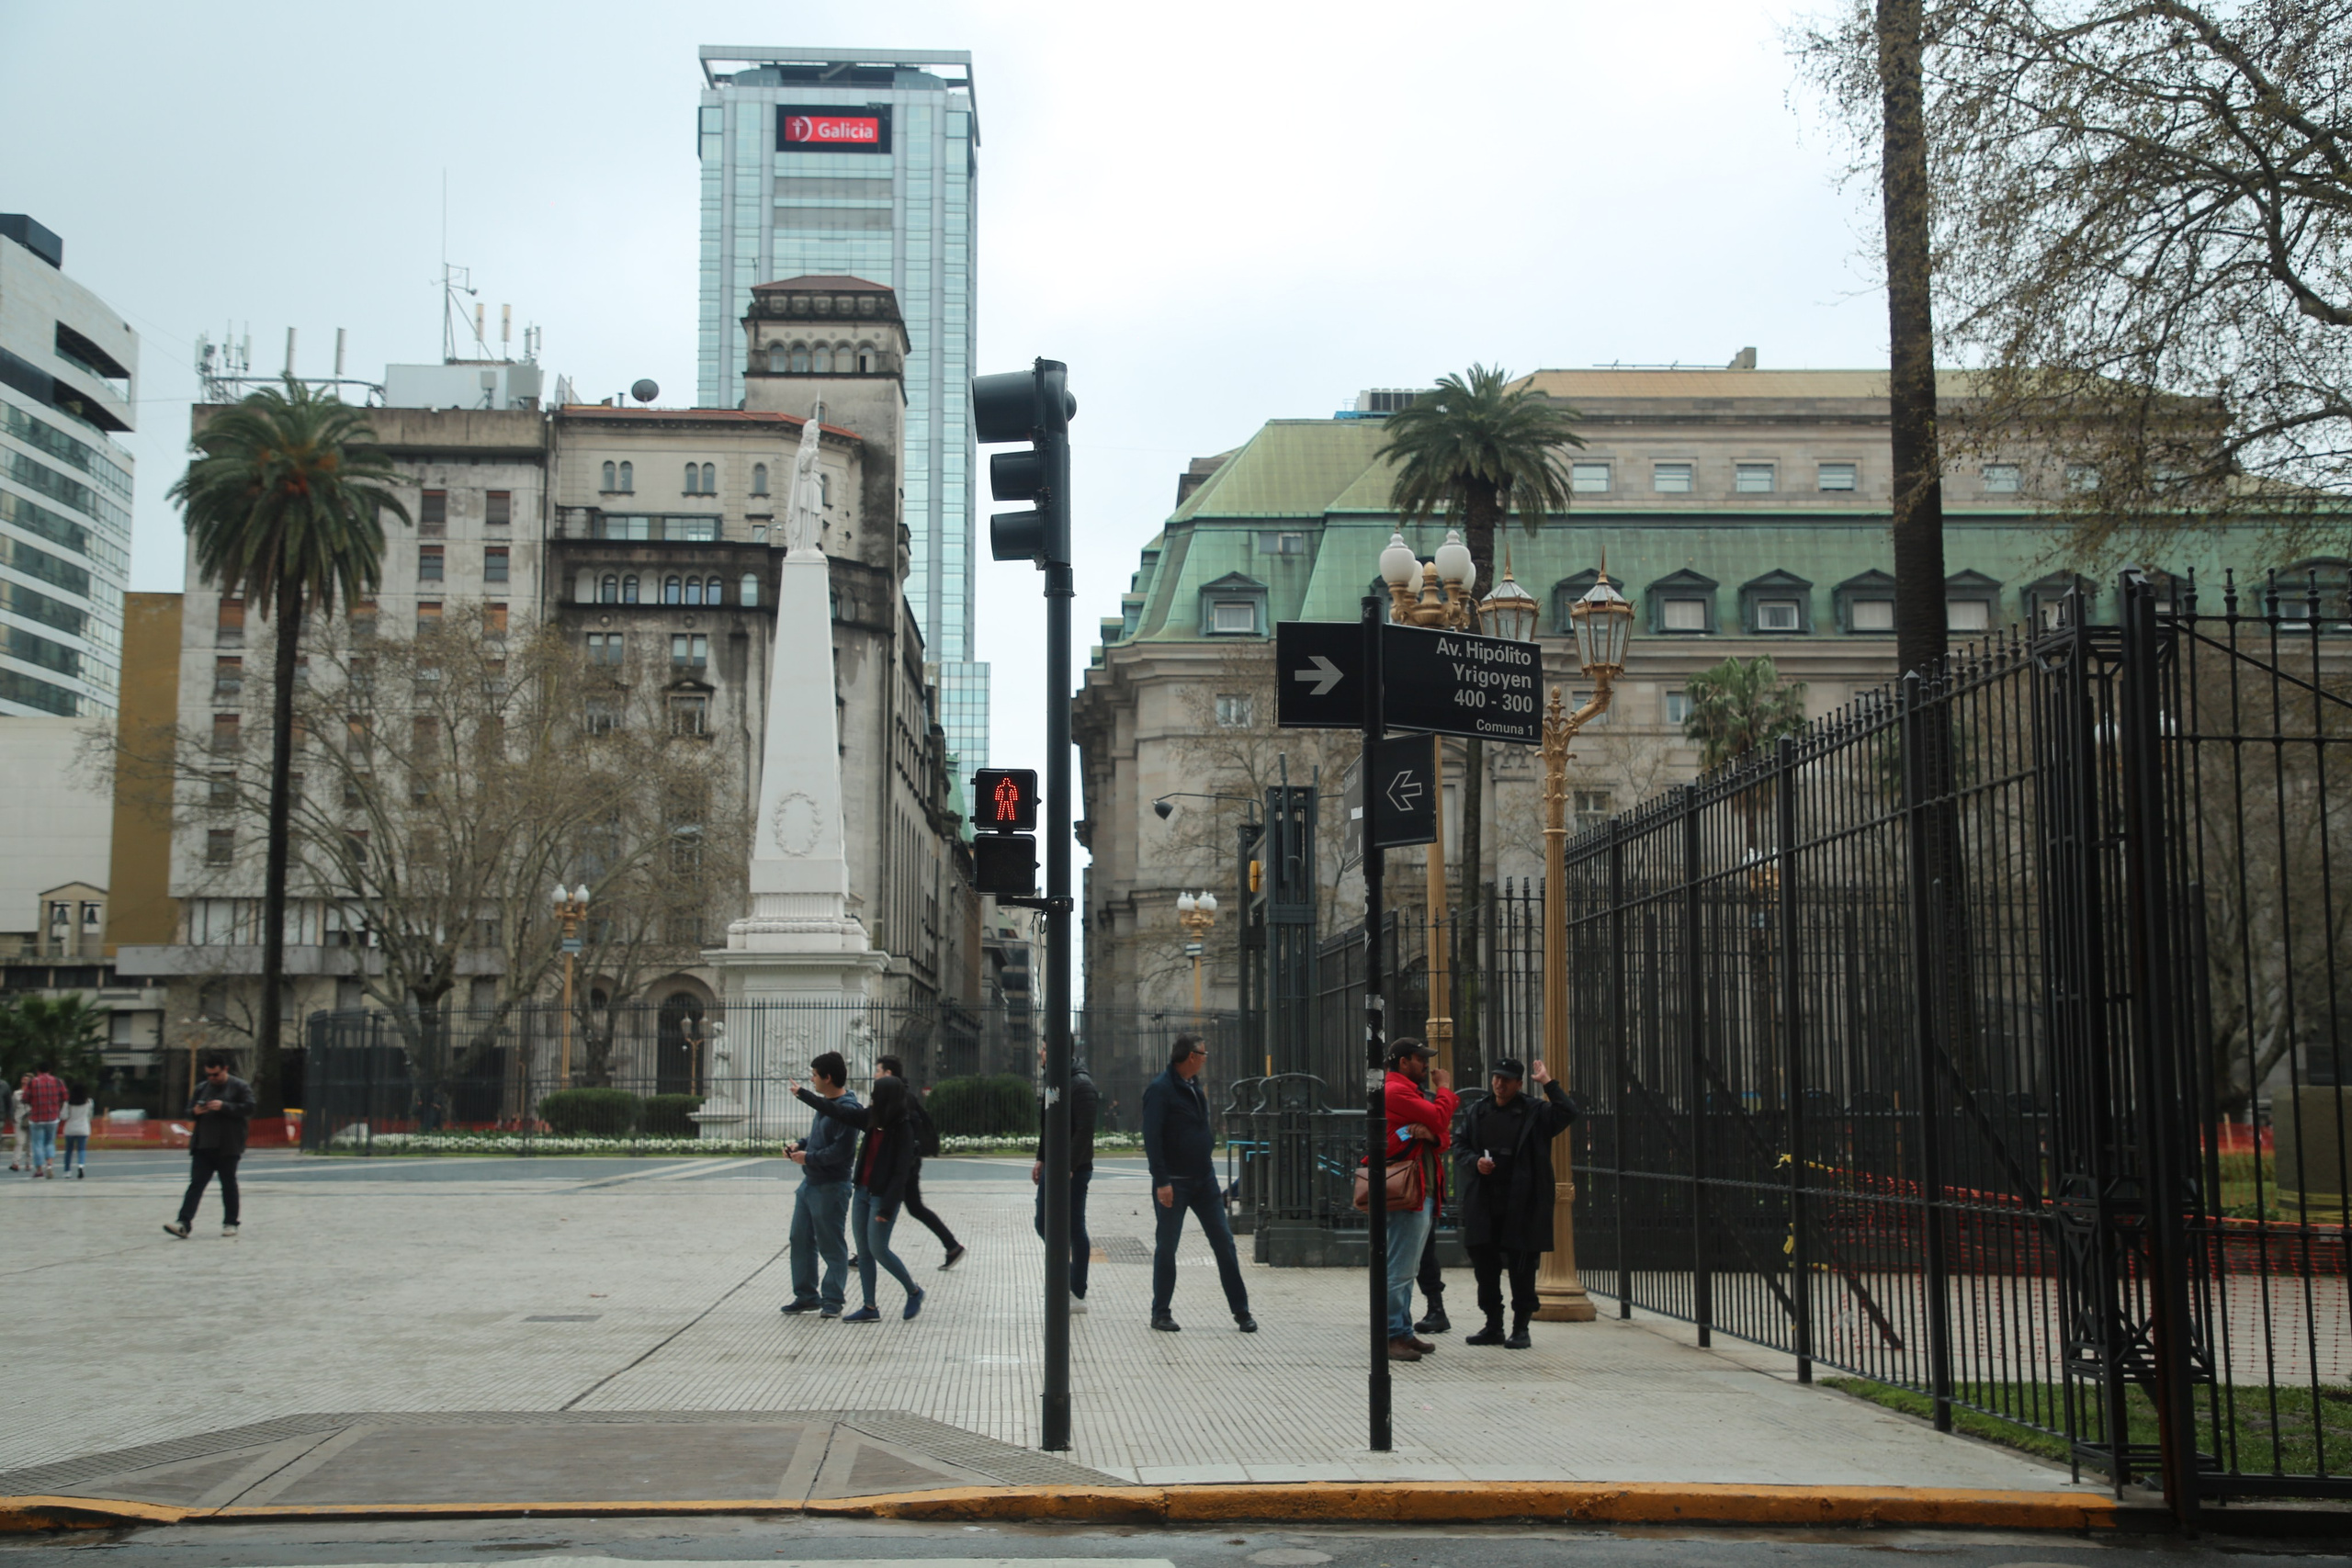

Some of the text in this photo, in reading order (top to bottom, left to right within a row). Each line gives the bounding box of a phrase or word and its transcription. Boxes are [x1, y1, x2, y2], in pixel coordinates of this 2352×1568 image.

[818, 121, 874, 139] Galicia
[1436, 637, 1532, 666] Av. Hipólito
[1453, 663, 1532, 689] Yrigoyen
[1454, 690, 1486, 708] 400
[1502, 694, 1533, 714] 300
[1476, 718, 1533, 737] Comuna 1
